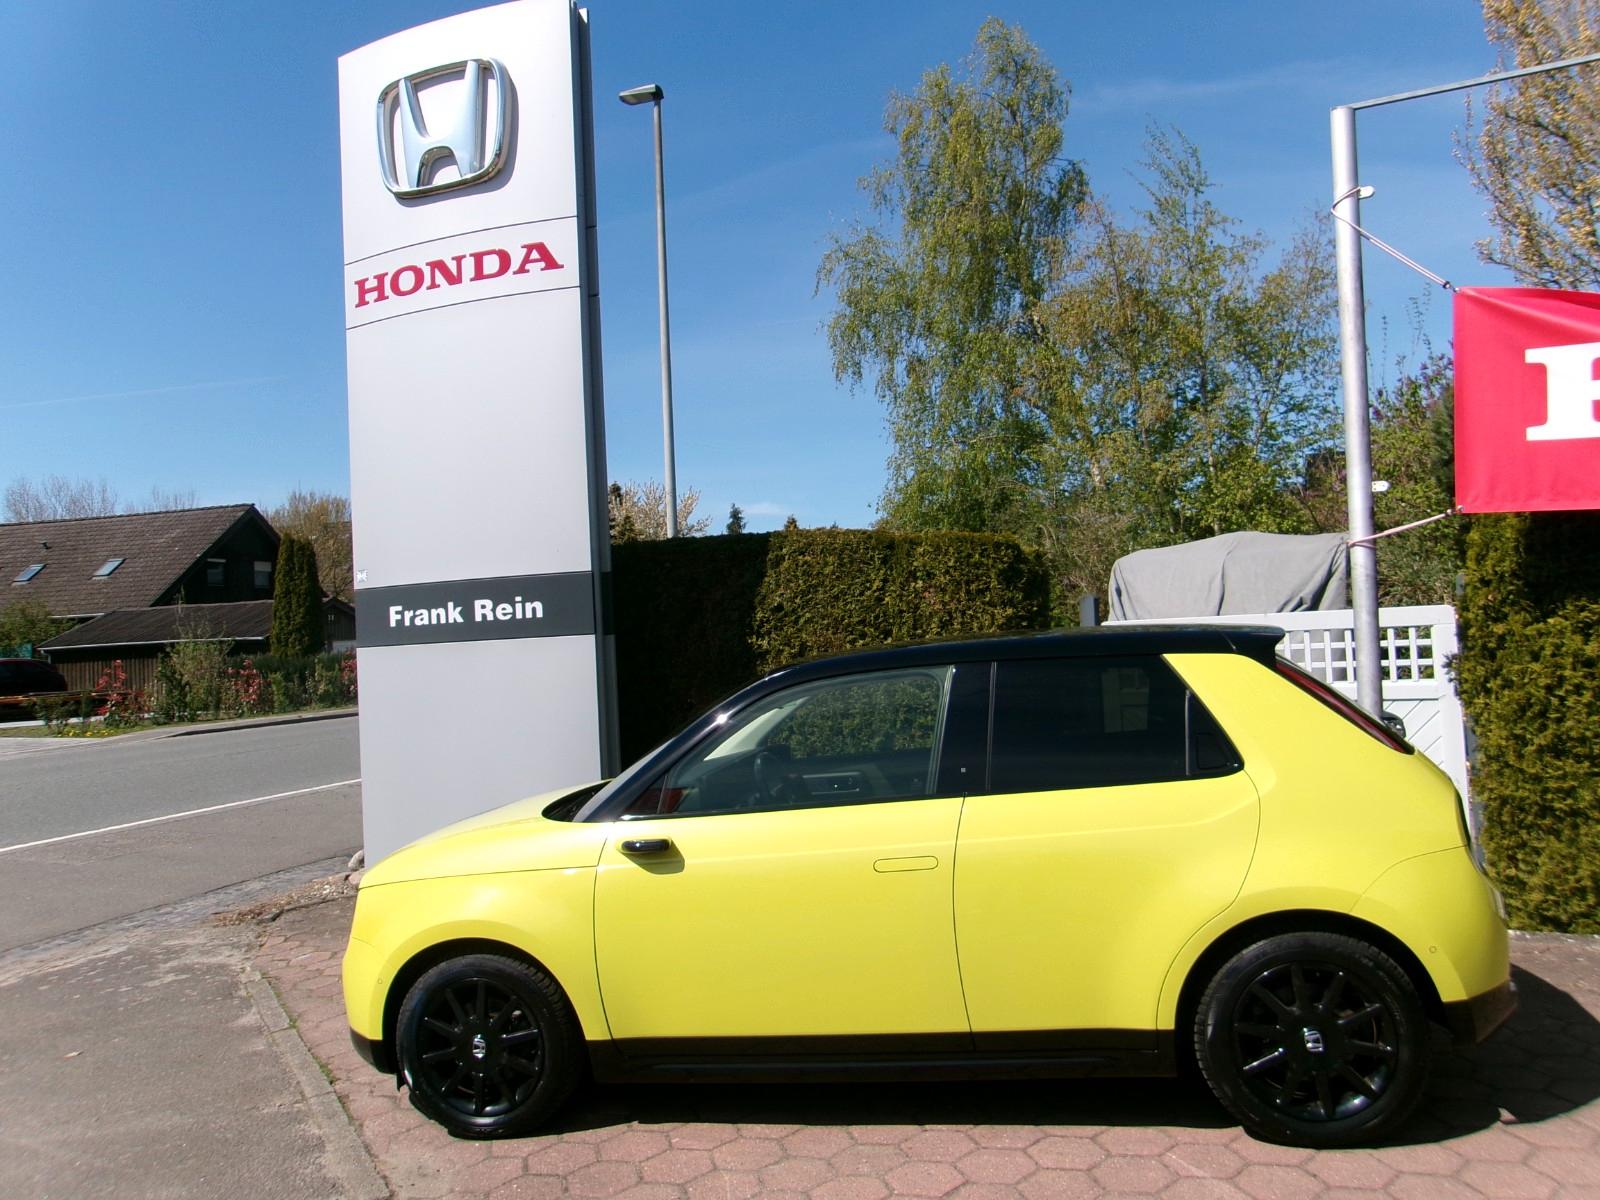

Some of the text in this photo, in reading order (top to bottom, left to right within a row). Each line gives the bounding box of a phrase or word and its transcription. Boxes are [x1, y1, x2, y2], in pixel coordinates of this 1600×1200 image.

[354, 241, 564, 308] HONDA
[389, 596, 543, 627] Frank Rein
